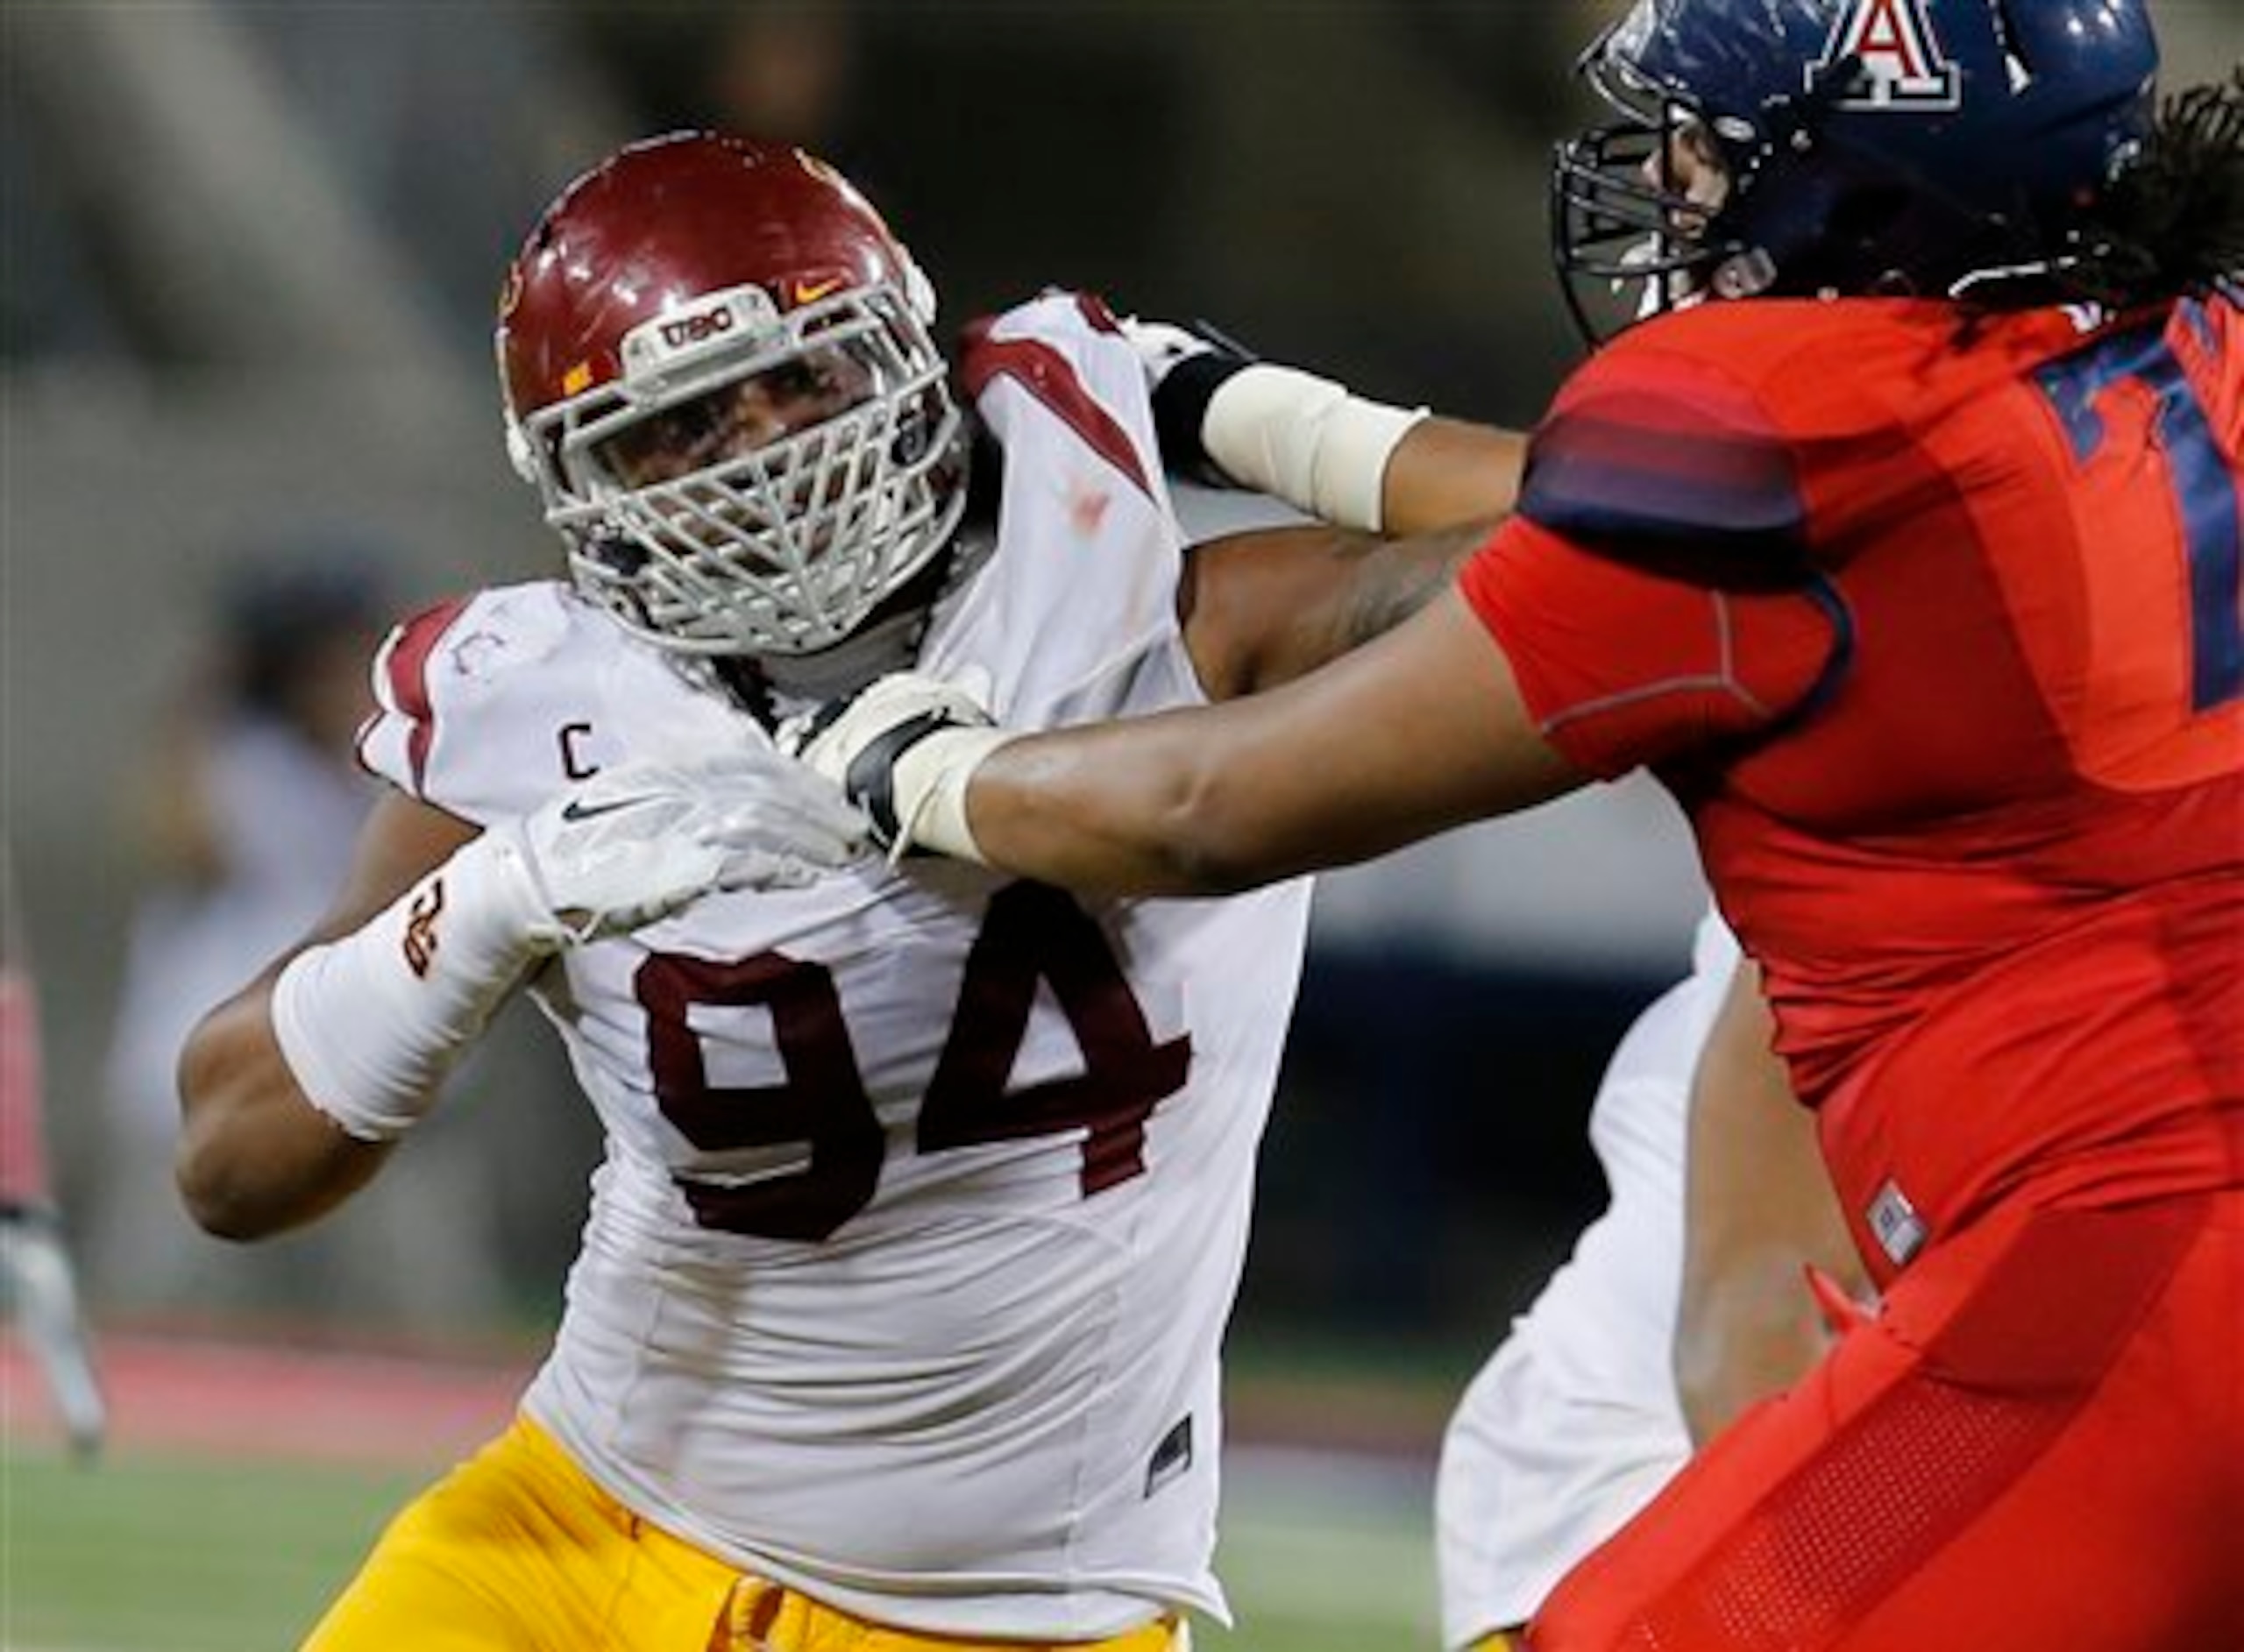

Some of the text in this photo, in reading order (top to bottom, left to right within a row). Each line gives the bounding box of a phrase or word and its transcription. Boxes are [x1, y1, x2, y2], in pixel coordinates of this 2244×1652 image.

[1803, 0, 1961, 111] A
[557, 722, 600, 782] C
[632, 875, 1190, 1241] 94
